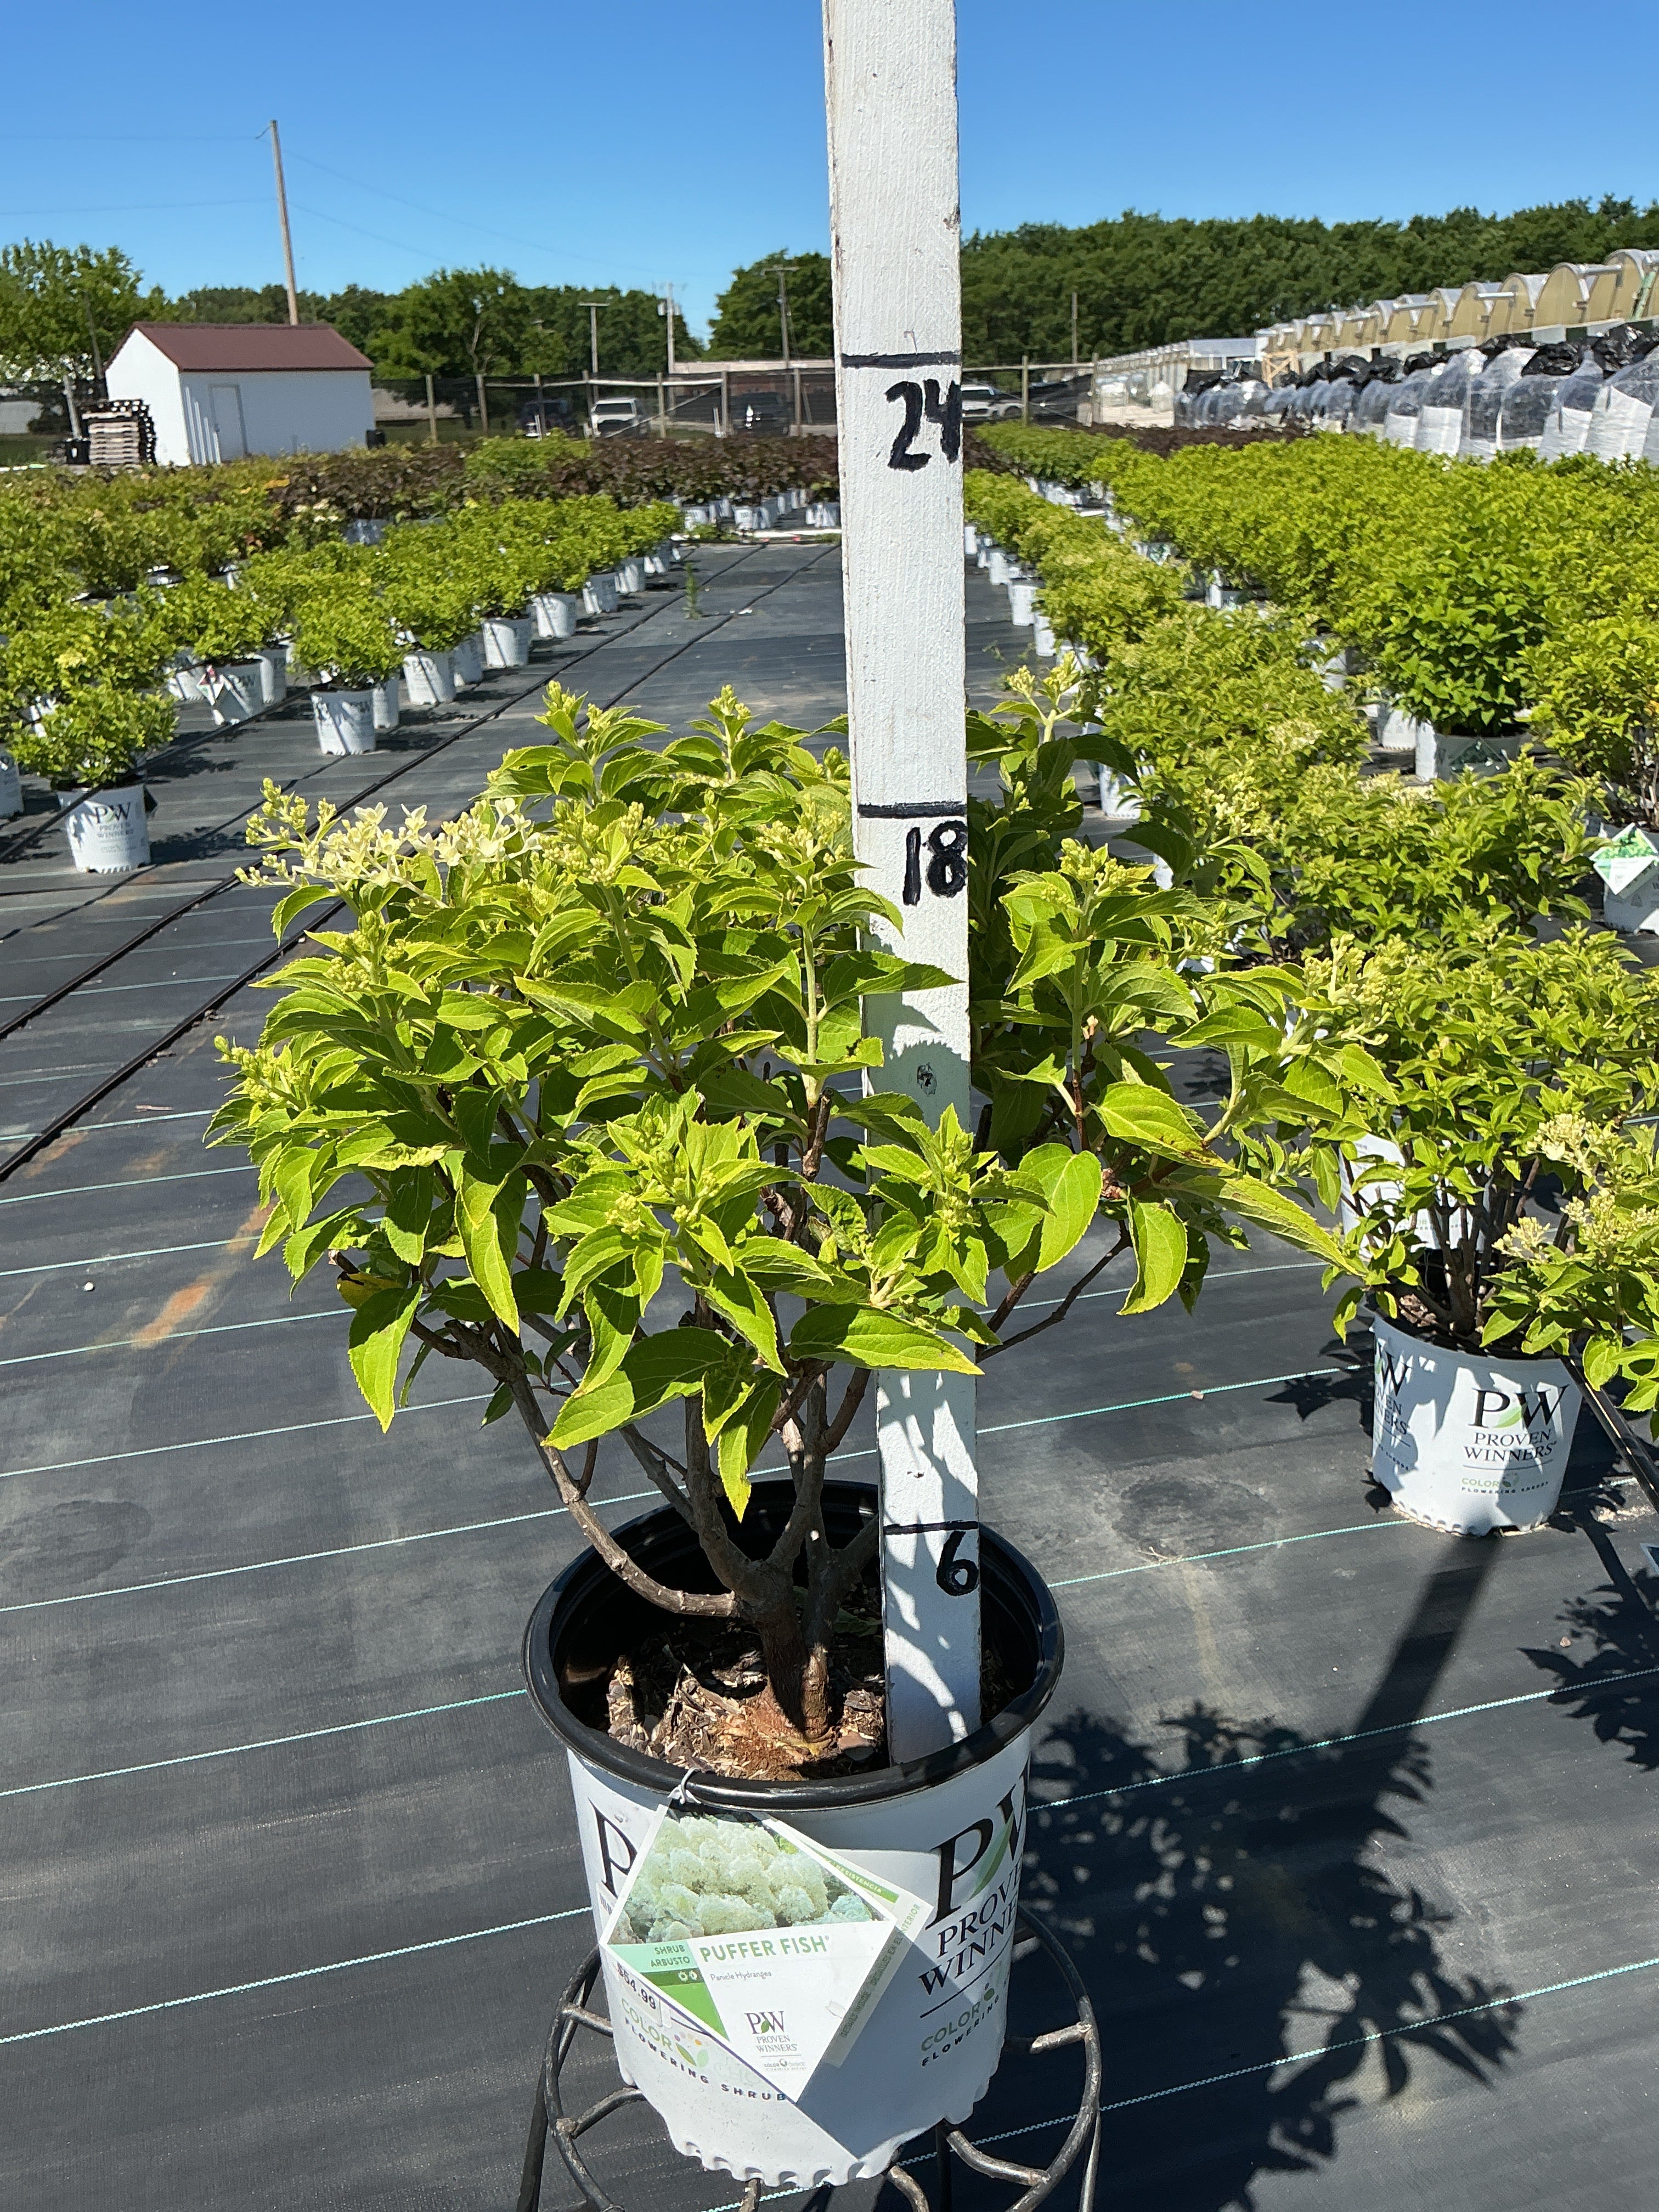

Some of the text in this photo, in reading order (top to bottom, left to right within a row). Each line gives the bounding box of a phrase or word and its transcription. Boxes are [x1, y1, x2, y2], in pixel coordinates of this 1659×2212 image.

[884, 378, 961, 472] 24
[93, 802, 131, 825] PW
[902, 820, 968, 906] 18
[1468, 1384, 1570, 1429] PW
[1474, 1429, 1551, 1448] PROVEN
[1462, 1477, 1499, 1488] COLOR
[936, 1531, 979, 1597] 6
[651, 1956, 691, 1967] ARBUSTO
[654, 1944, 686, 1955] SHRUB
[699, 1940, 776, 1962] PUFFER
[616, 1961, 657, 2010] $54.99
[710, 1970, 772, 1982] Panicle Hydrangea
[621, 1997, 673, 2052] COLOR
[744, 2011, 785, 2034] PW
[756, 2034, 791, 2044] PROVEN
[921, 2001, 981, 2052] COLOR
[921, 1993, 999, 2067] FLOWERING
[624, 2016, 709, 2085] FLOWERING
